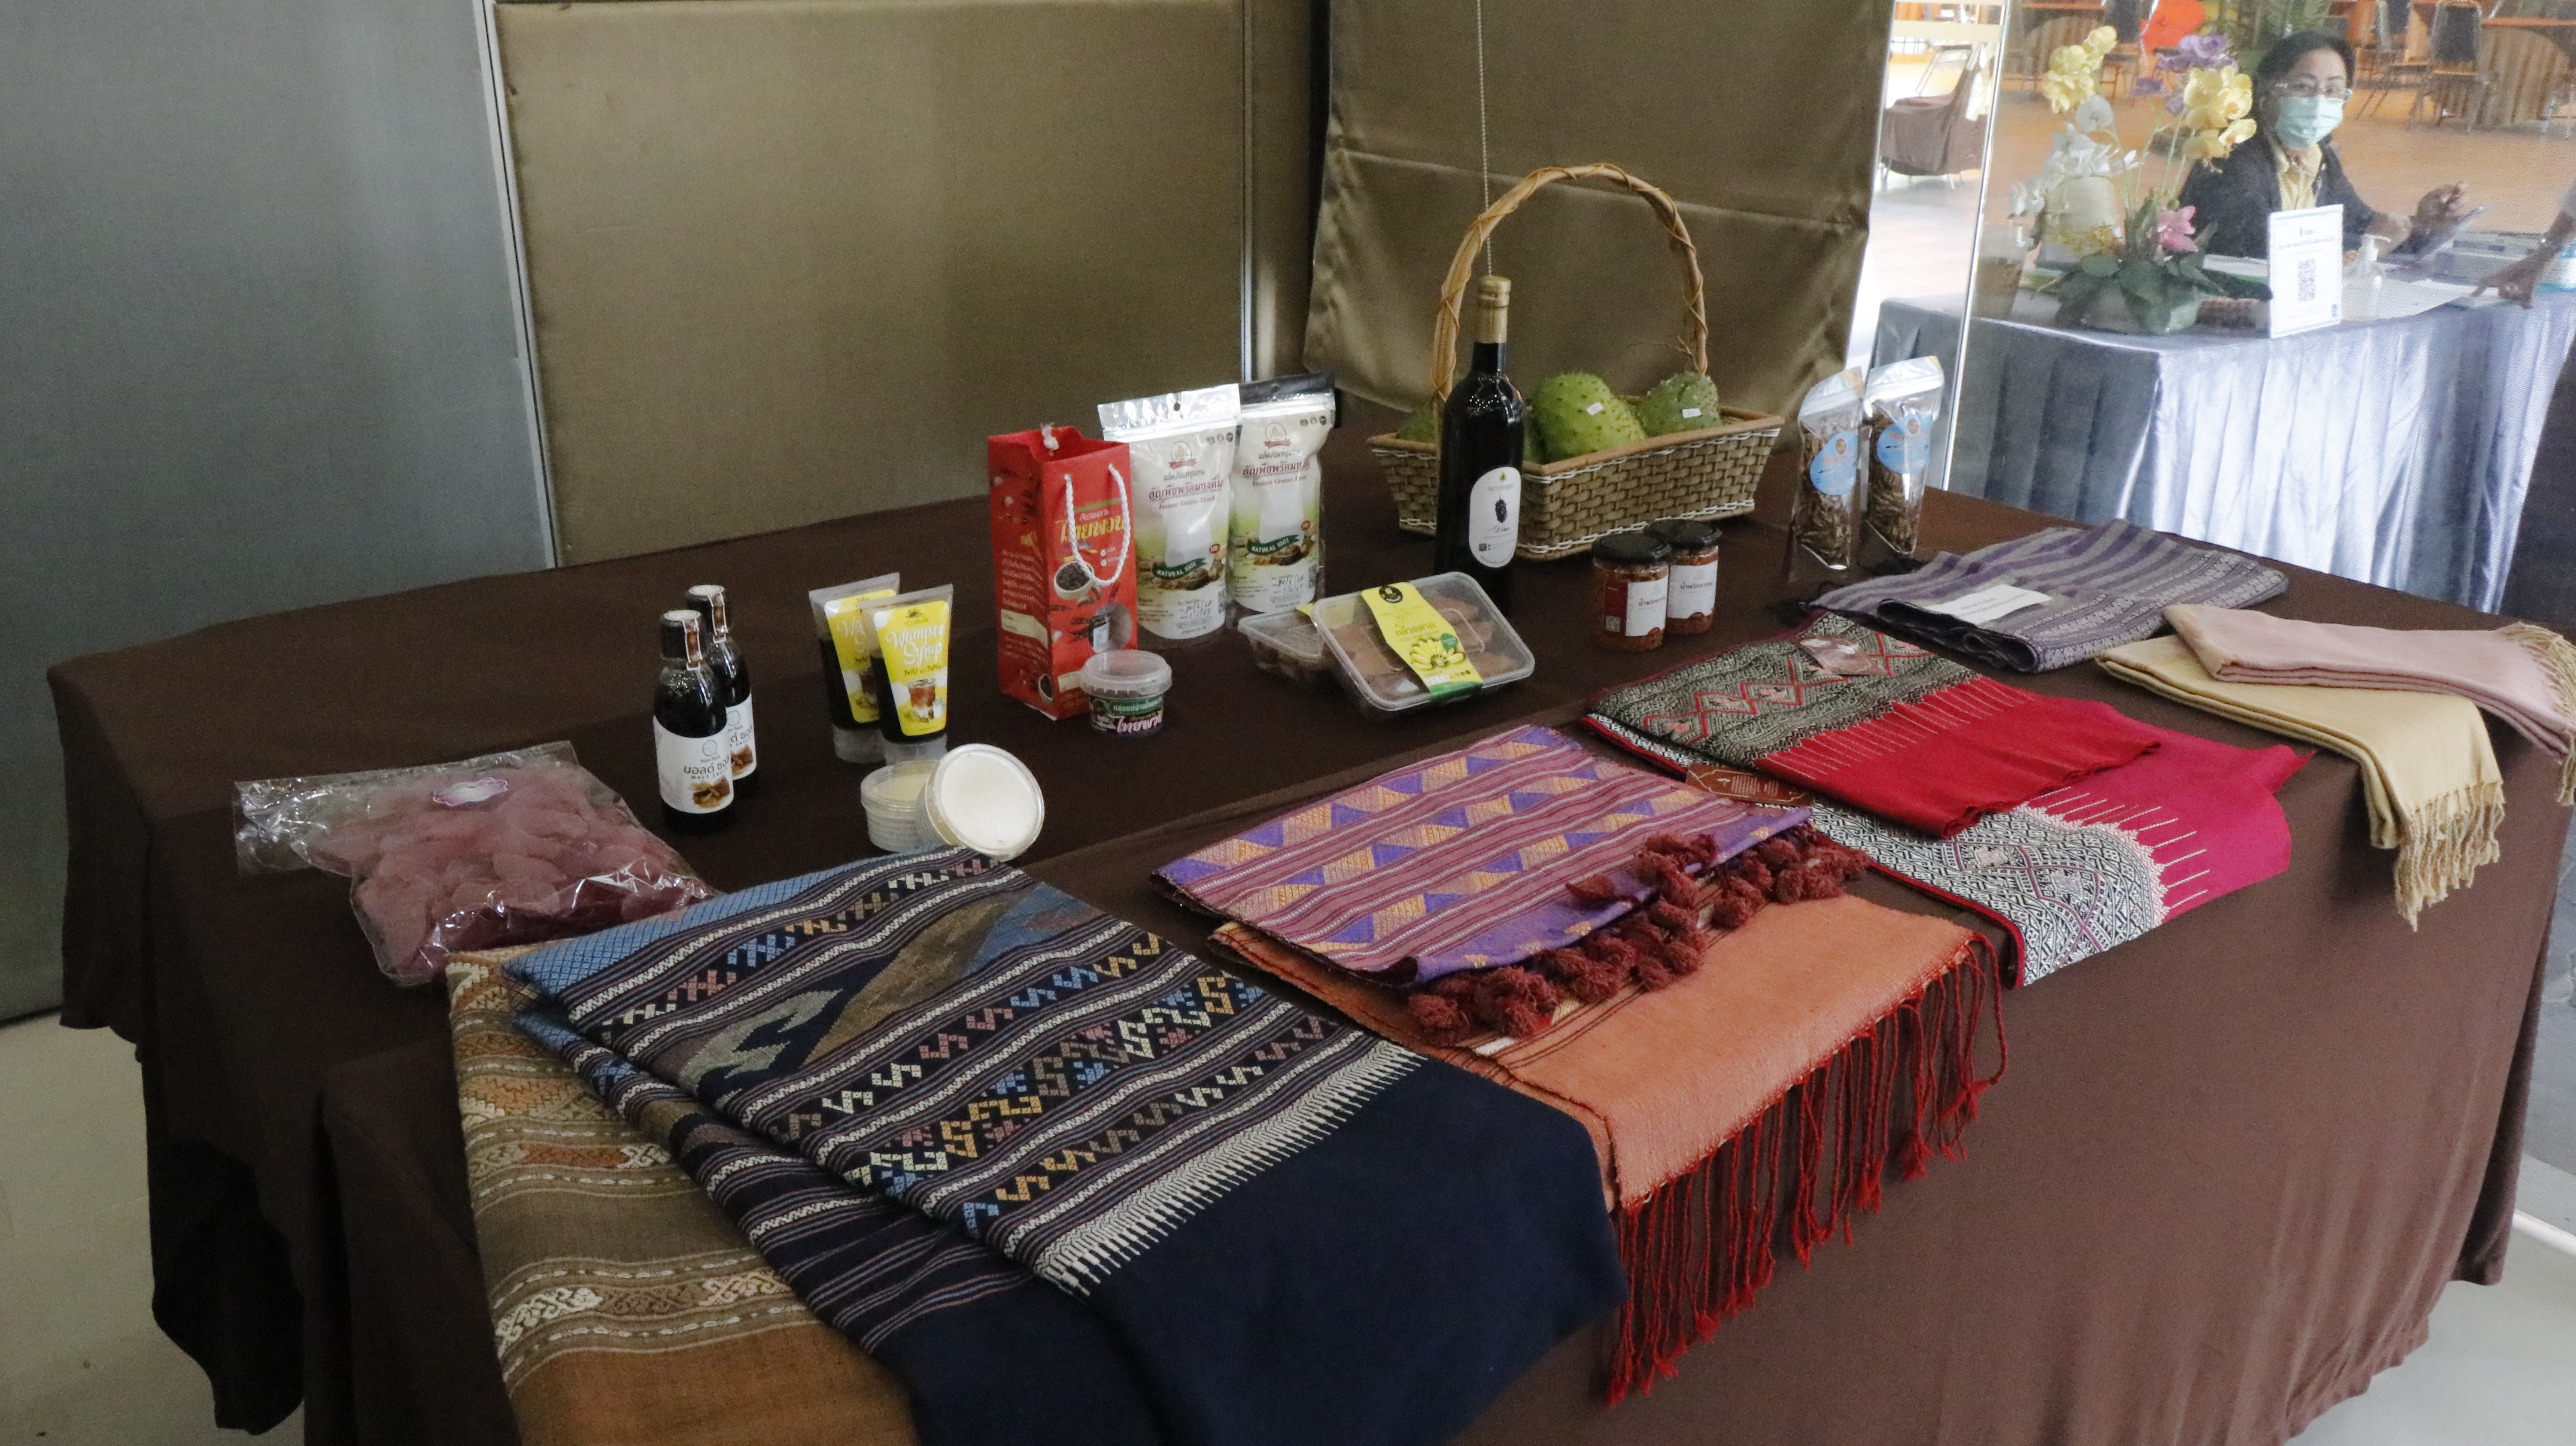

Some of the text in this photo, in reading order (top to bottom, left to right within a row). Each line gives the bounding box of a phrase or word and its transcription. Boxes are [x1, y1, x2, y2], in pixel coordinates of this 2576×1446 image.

[886, 624, 945, 650] Wampee
[903, 641, 942, 667] Syrup
[683, 762, 714, 775] มอลต์
